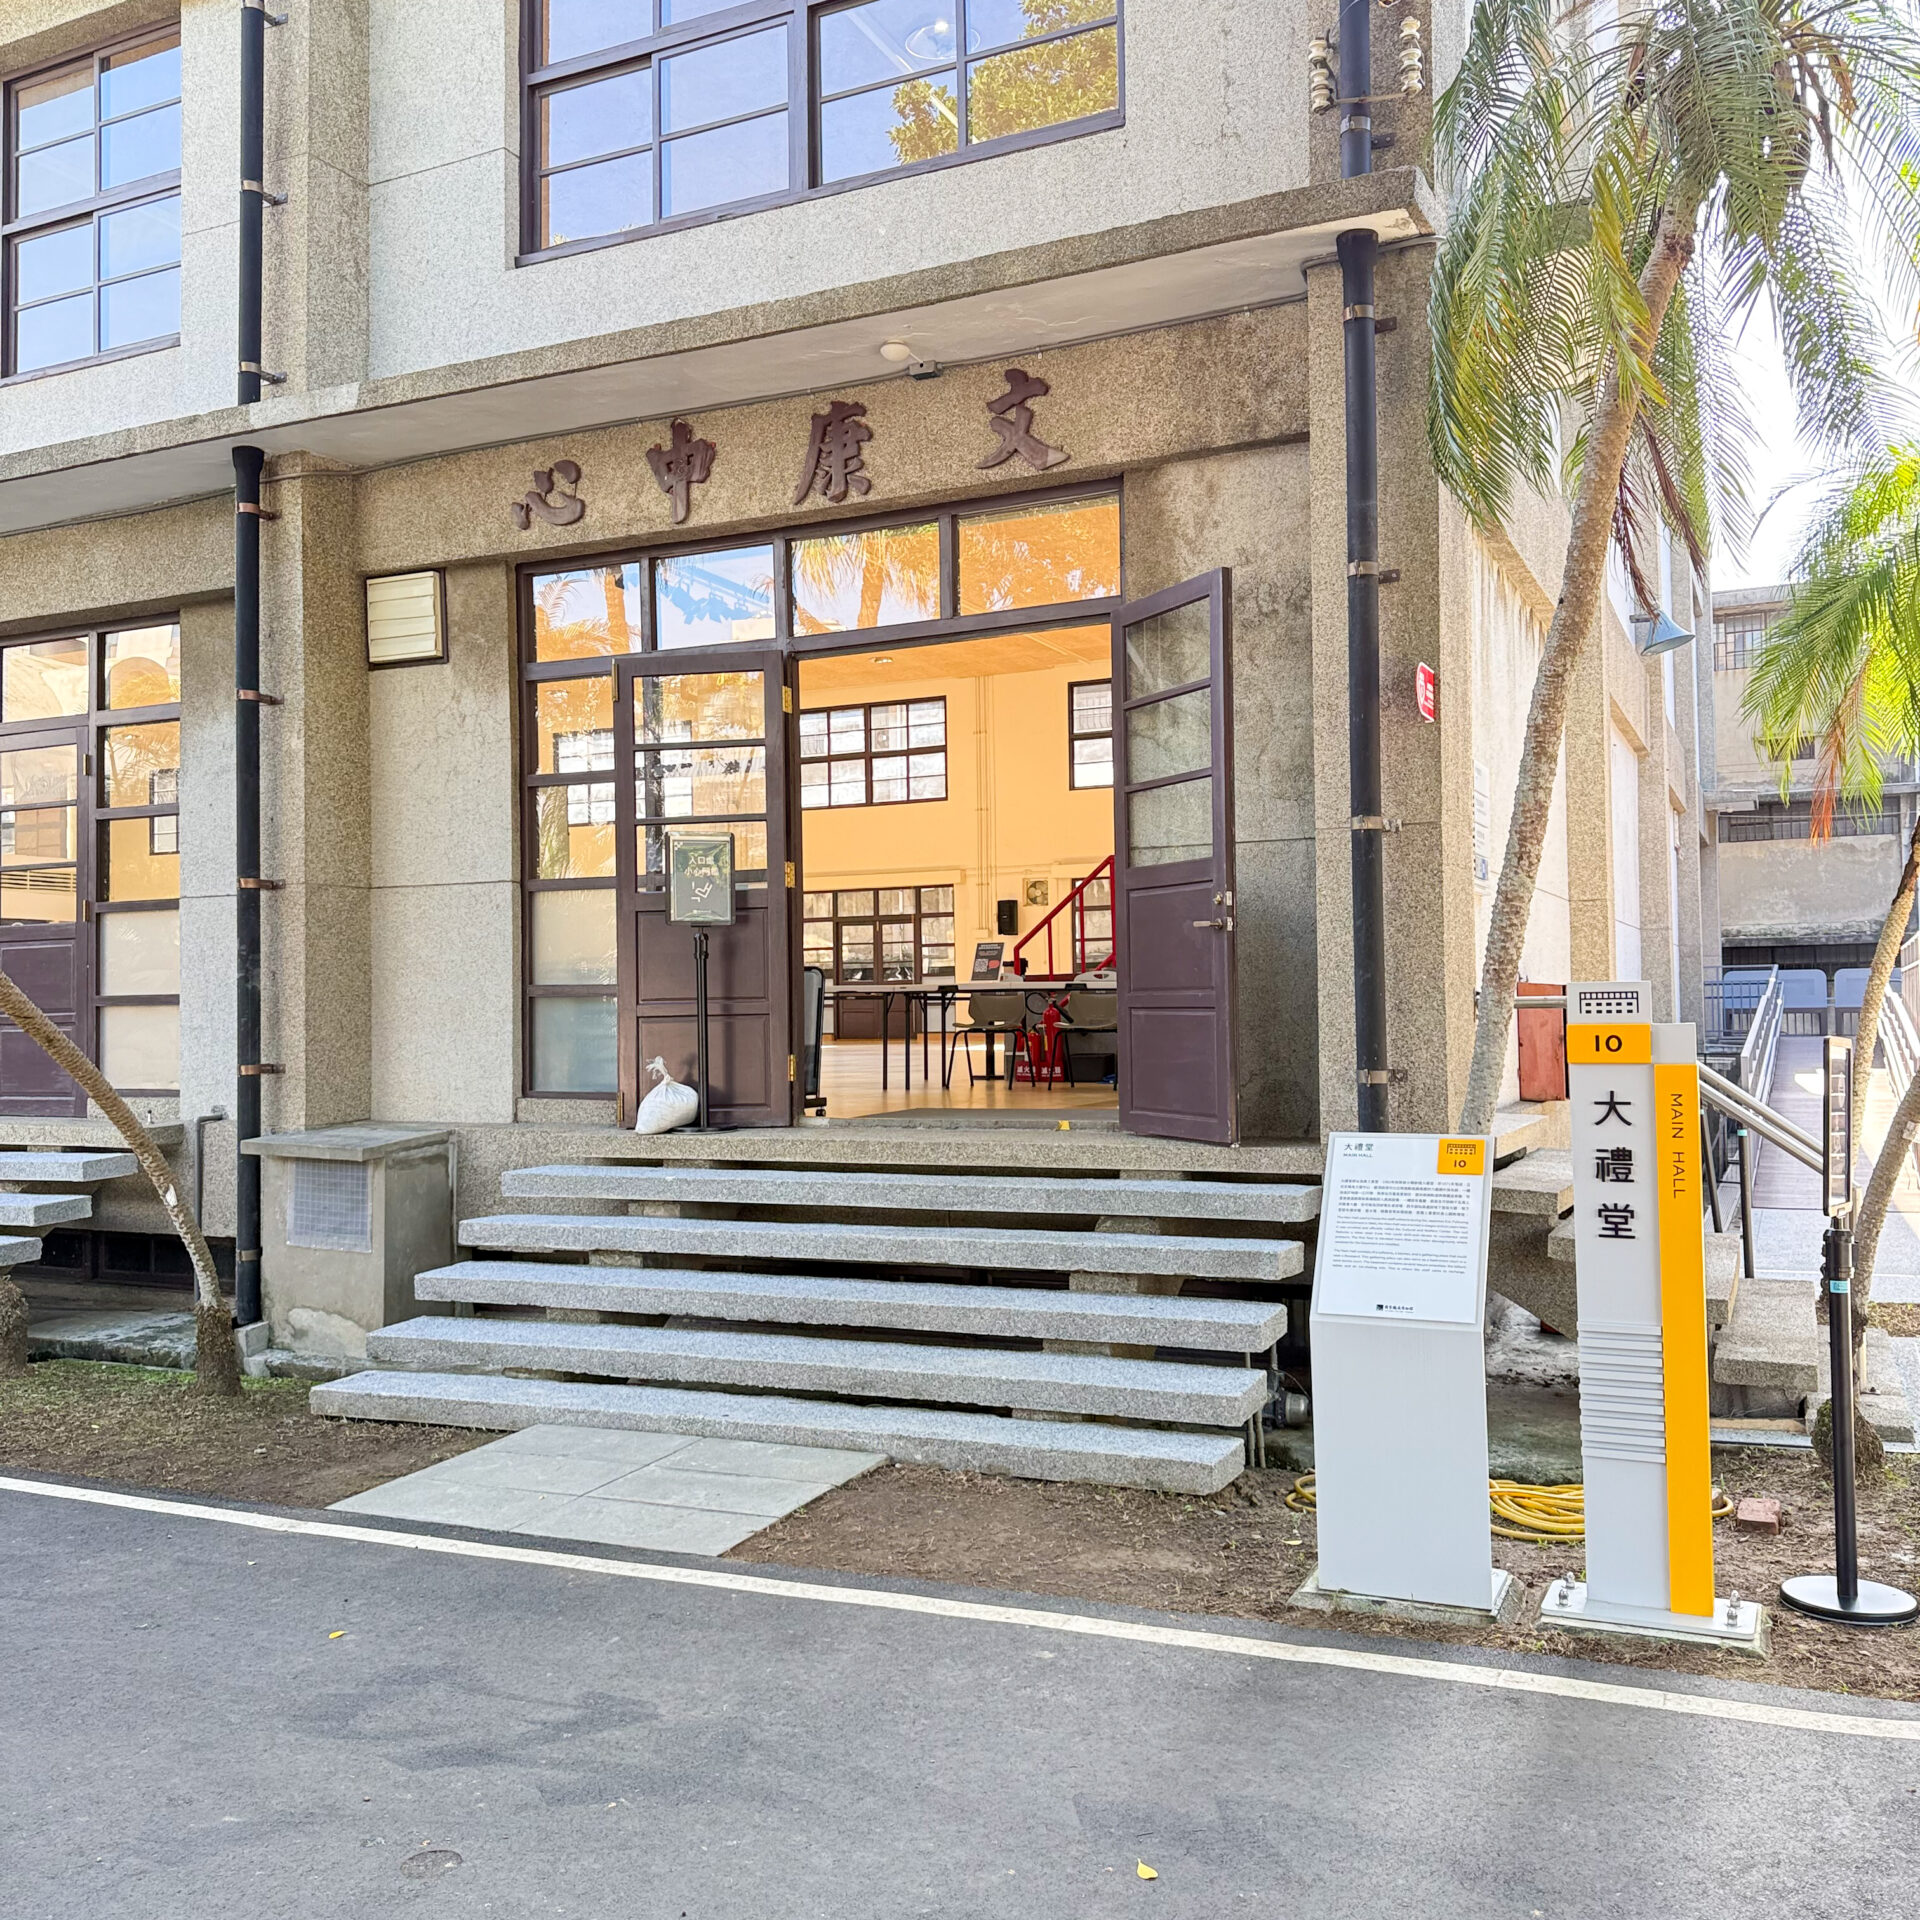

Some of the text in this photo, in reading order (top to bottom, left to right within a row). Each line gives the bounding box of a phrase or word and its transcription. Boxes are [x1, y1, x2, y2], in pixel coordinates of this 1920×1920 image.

[1594, 1034, 1623, 1053] 10
[1453, 1159, 1467, 1168] 10
[1593, 1090, 1637, 1240] 大禮堂
[1670, 1093, 1686, 1200] MAIN HALL
